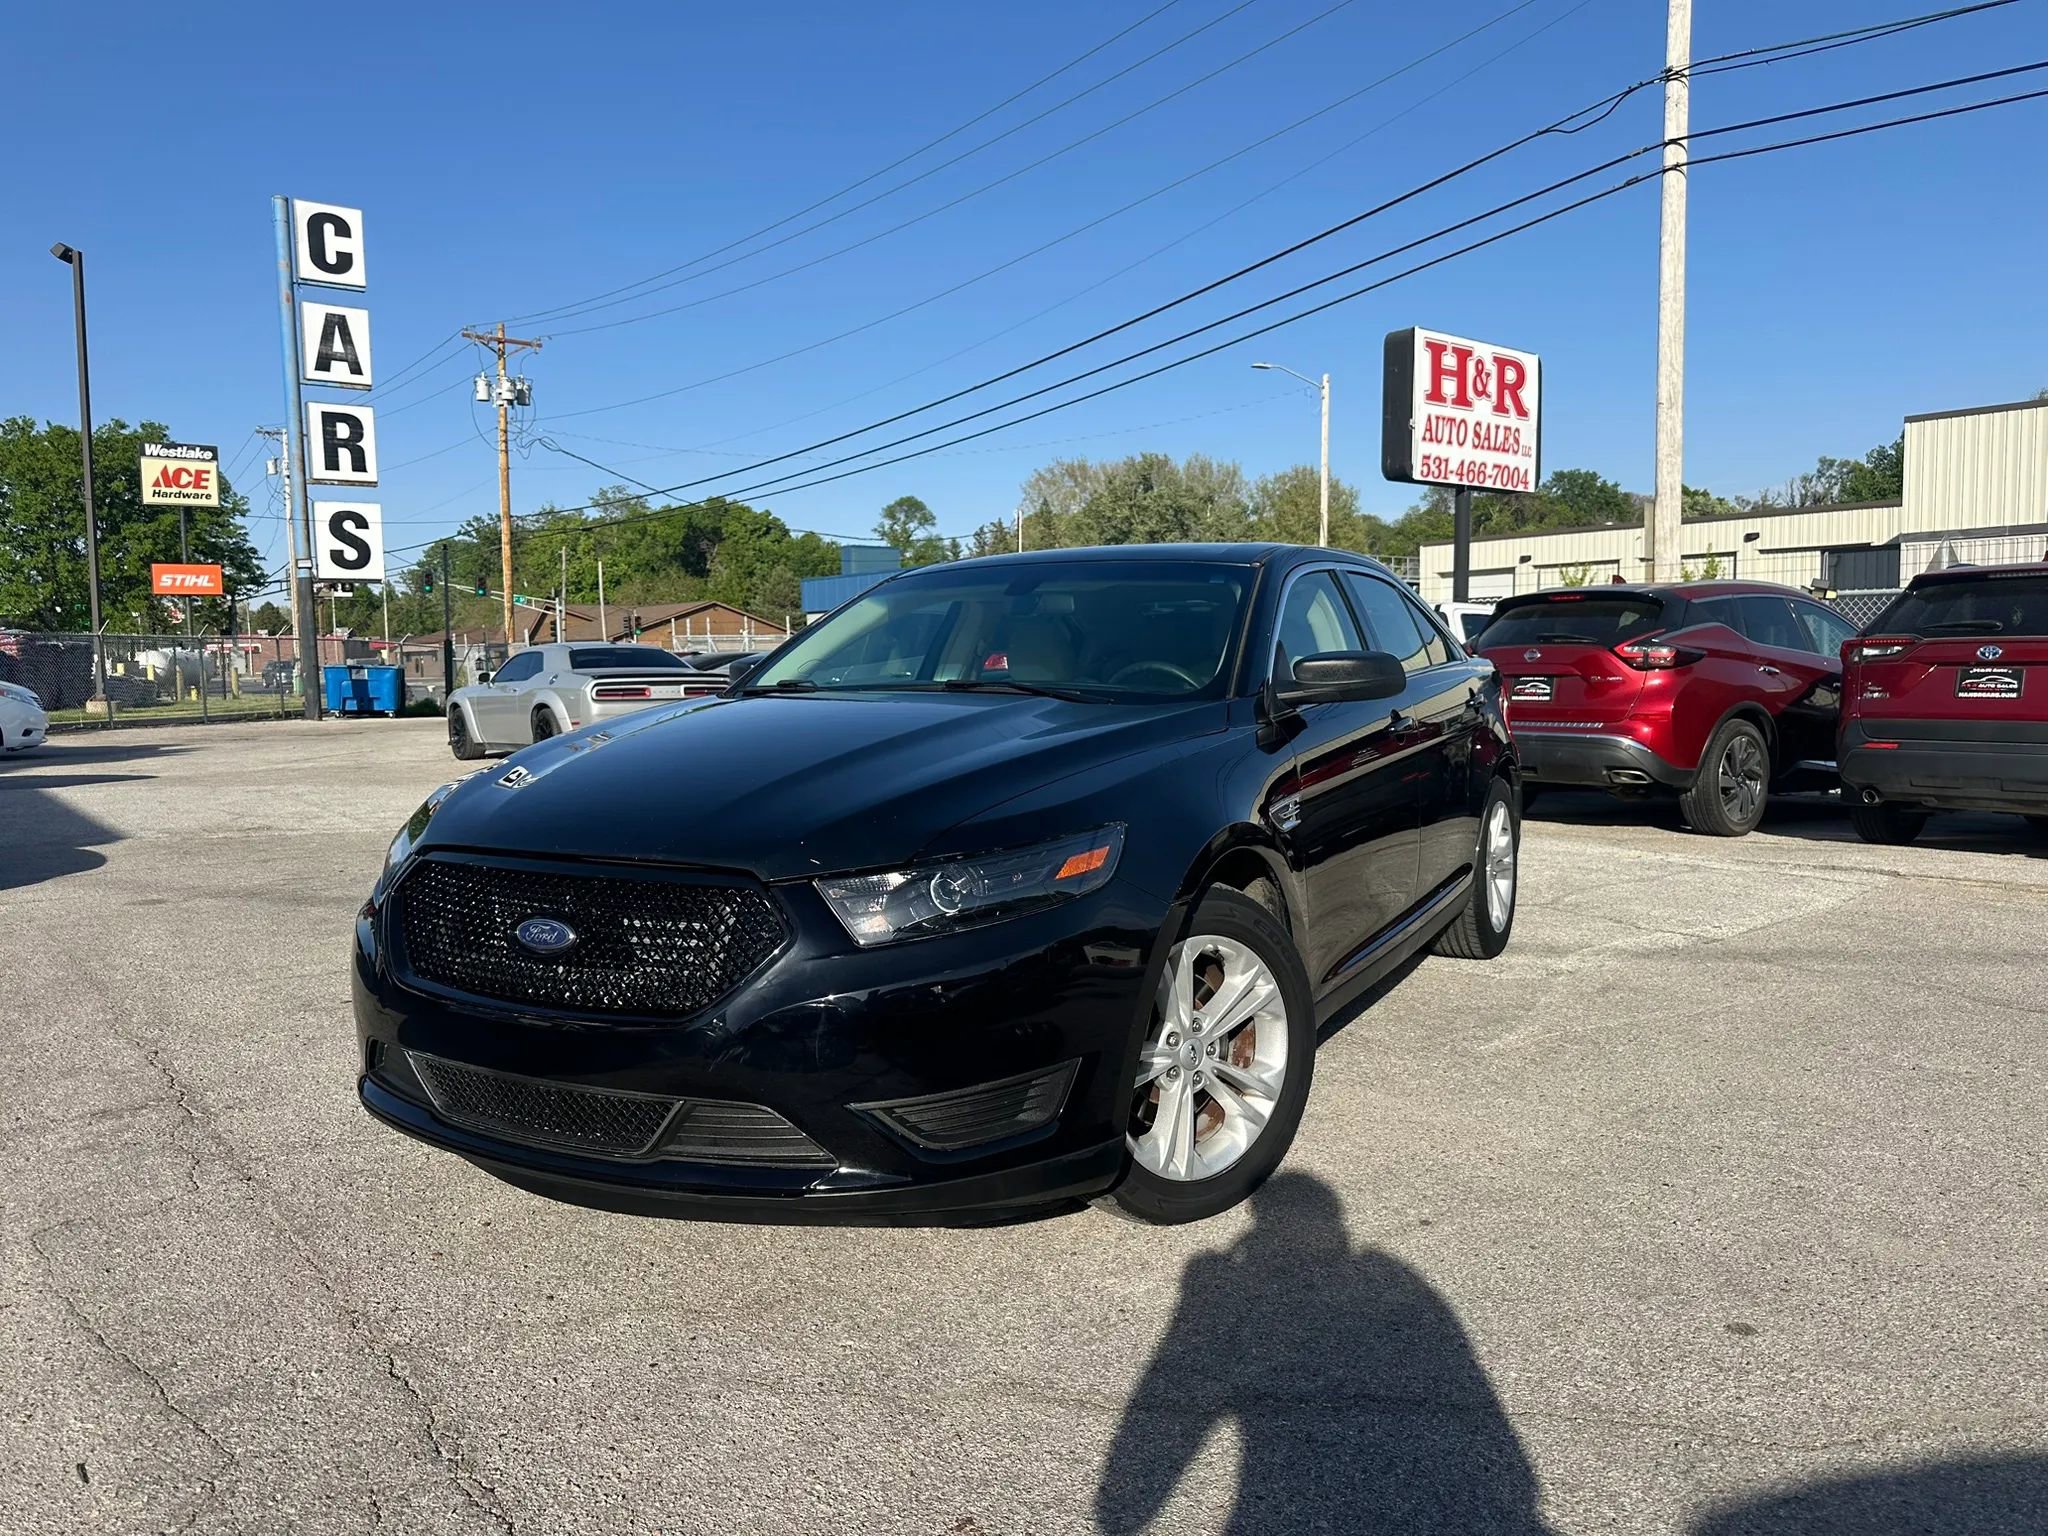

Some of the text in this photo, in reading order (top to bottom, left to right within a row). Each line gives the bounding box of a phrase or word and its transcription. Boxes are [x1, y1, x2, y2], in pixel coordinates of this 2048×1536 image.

[306, 211, 372, 572] CARS
[1424, 338, 1529, 419] H&R
[1422, 414, 1468, 447] AUTO
[1472, 420, 1520, 455] SALES
[144, 443, 213, 460] Westlake
[151, 463, 211, 490] ACE
[1420, 453, 1530, 490] 531-466-7004
[151, 489, 212, 500] Hardware
[159, 573, 215, 587] STIHL
[525, 923, 559, 943] Ford
